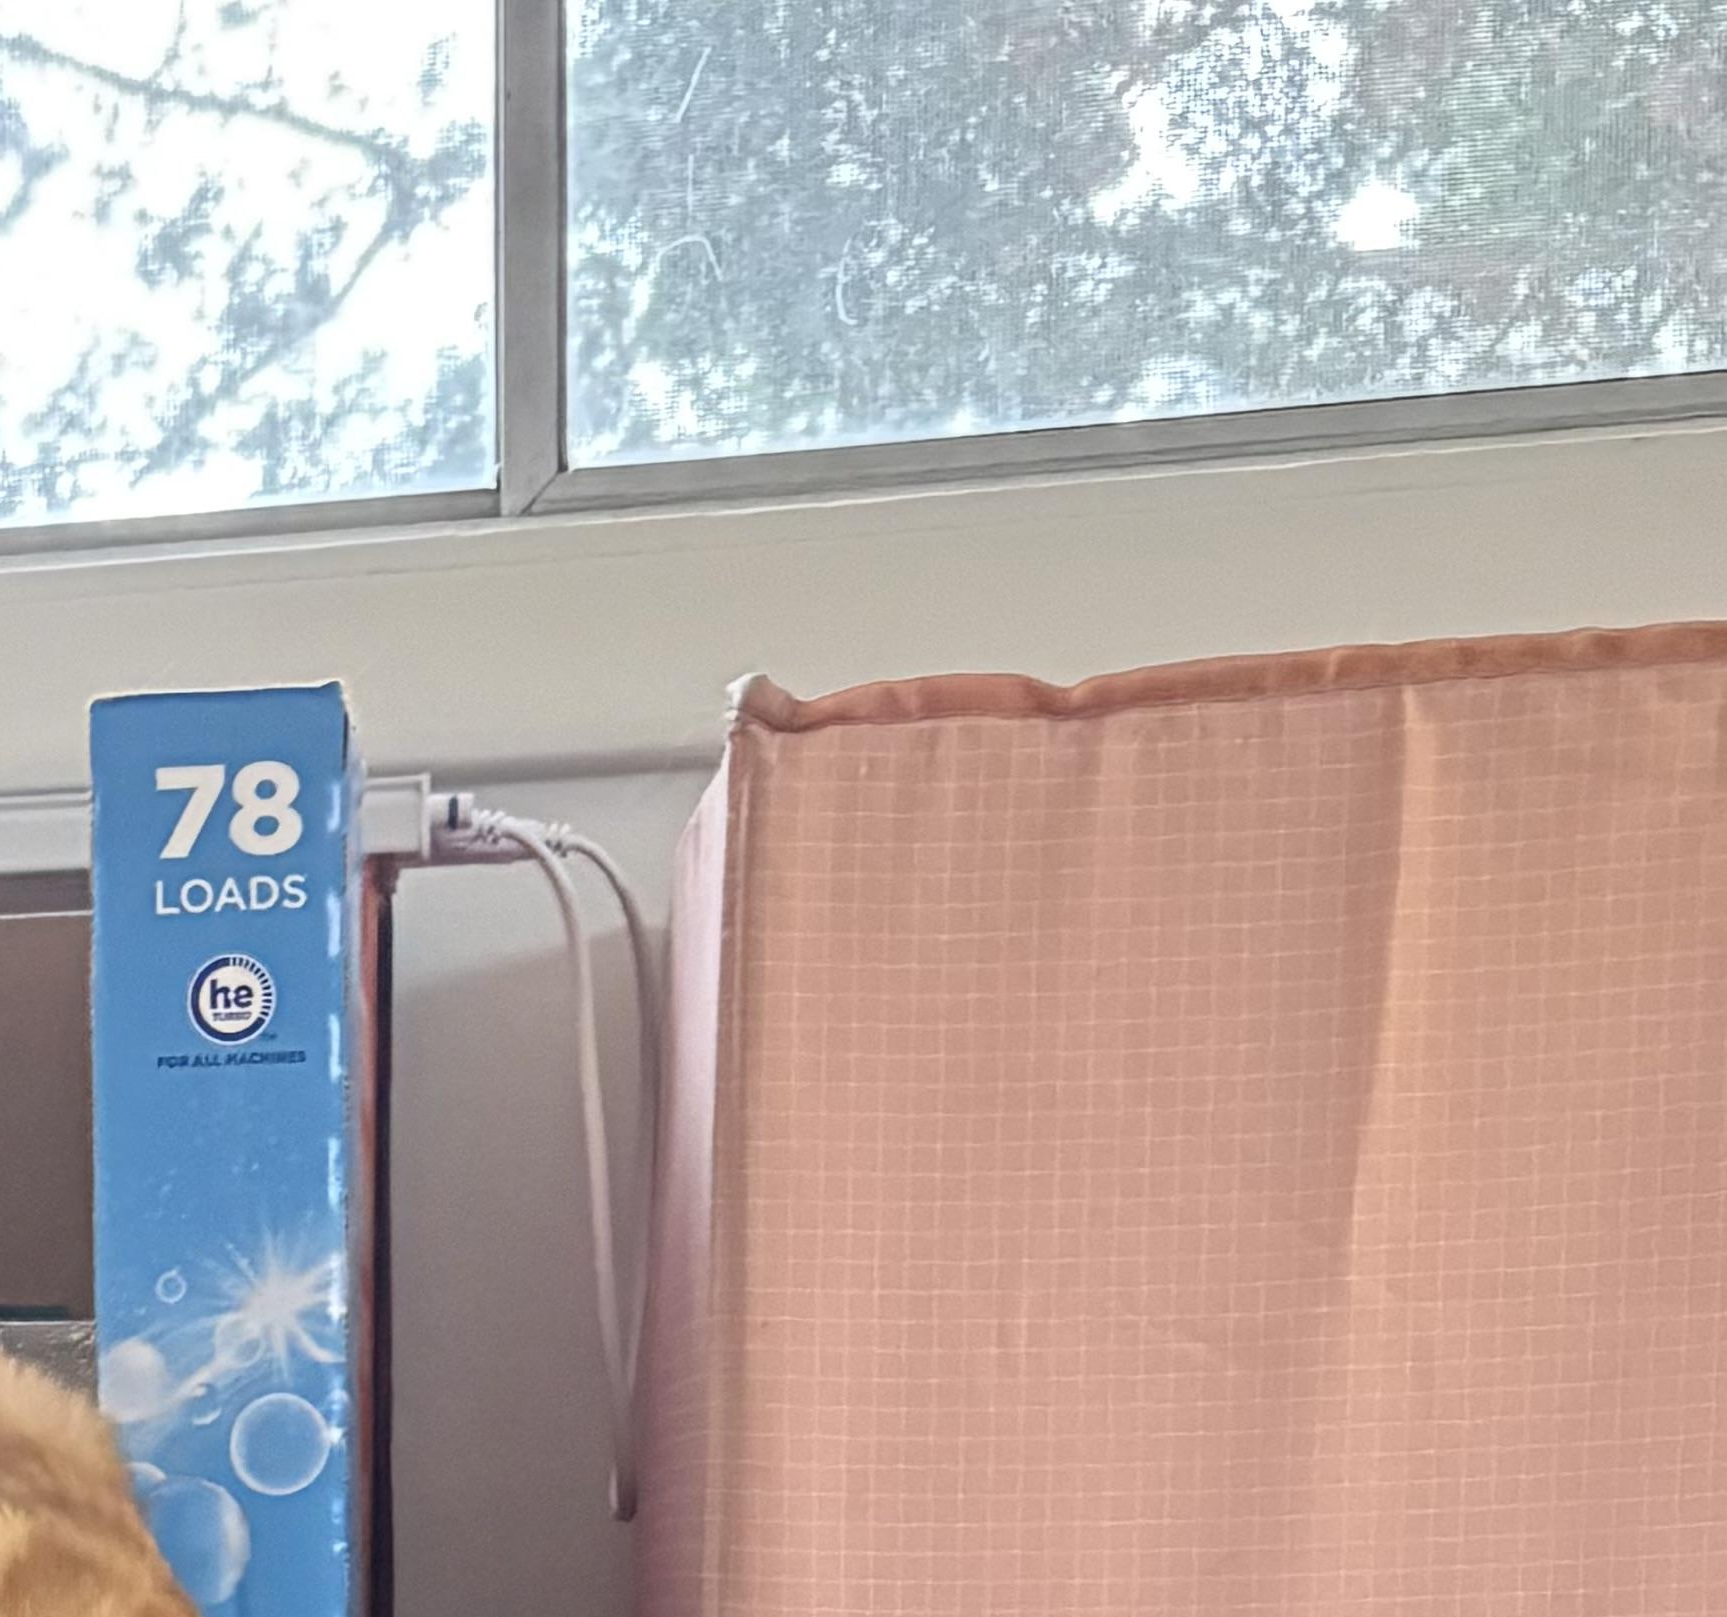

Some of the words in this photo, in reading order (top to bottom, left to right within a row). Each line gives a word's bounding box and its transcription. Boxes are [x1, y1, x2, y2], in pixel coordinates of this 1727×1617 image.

[155, 760, 303, 859] 78
[154, 874, 308, 915] LOADS
[209, 978, 254, 1009] he
[157, 1055, 189, 1068] FOR
[191, 1053, 221, 1067] ALL
[224, 1050, 307, 1066] MACHINES
